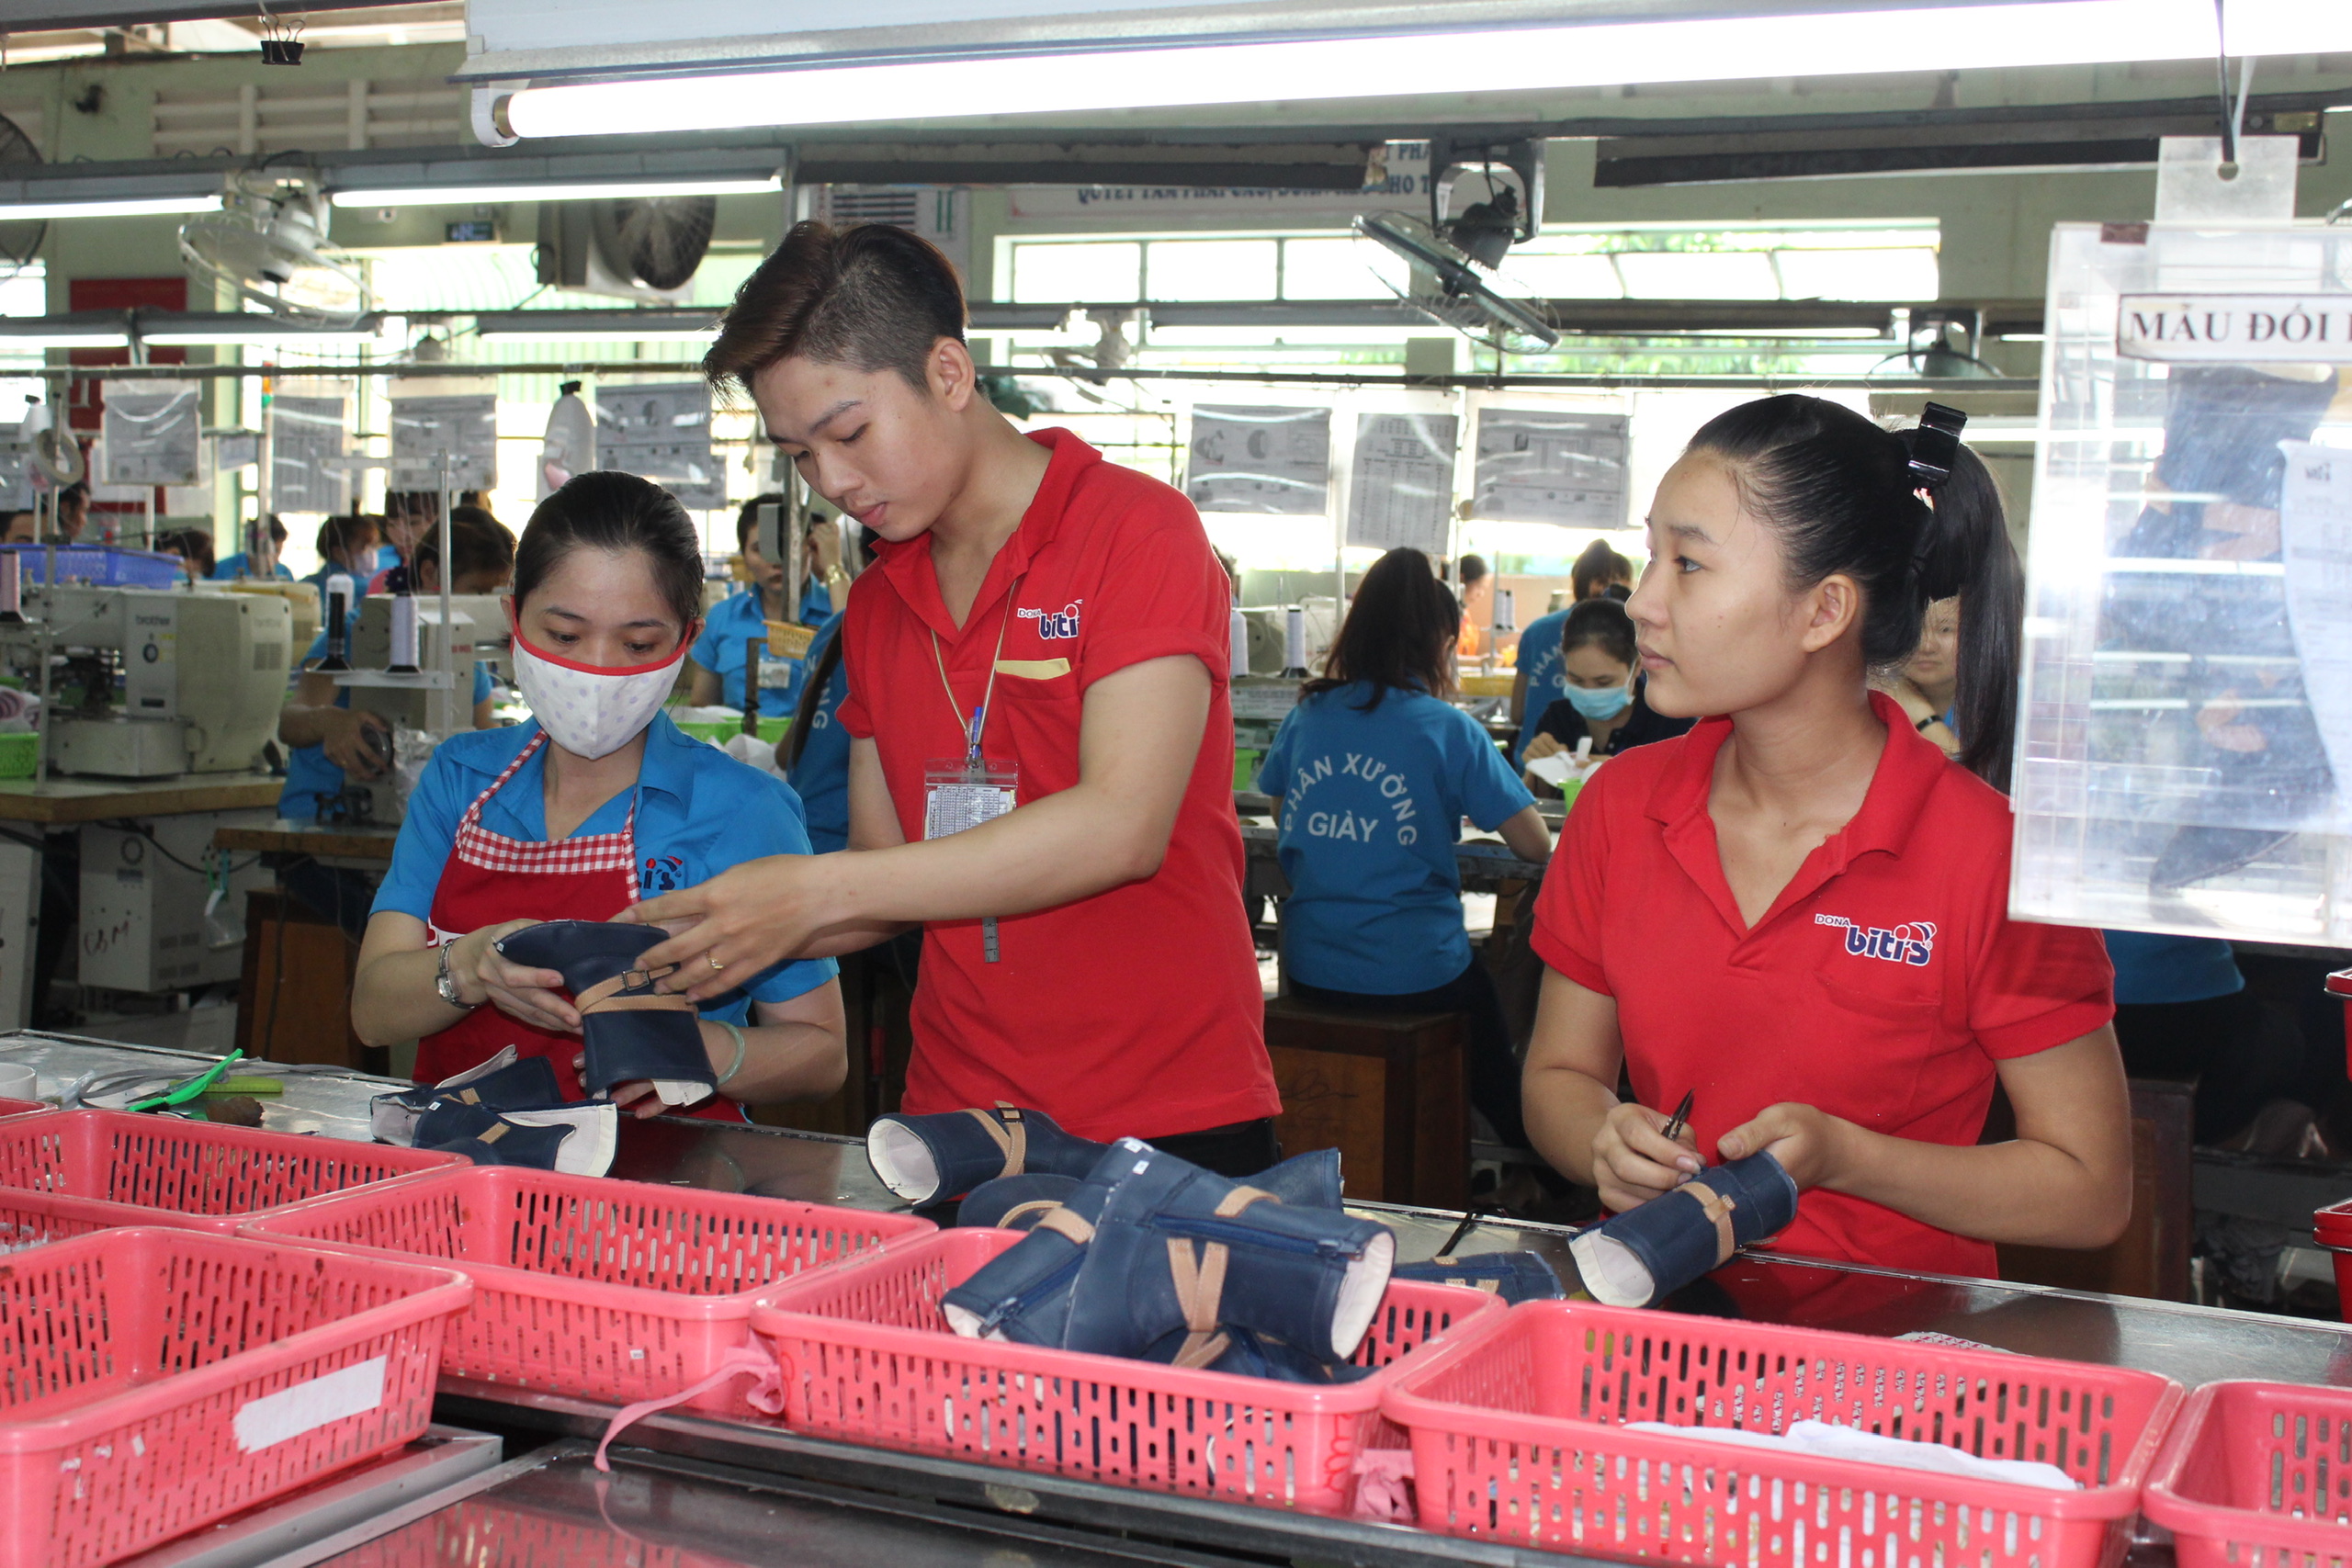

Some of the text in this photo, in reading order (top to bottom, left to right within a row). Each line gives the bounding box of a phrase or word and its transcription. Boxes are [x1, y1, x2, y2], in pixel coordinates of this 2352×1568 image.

[1284, 752, 1418, 846] PHÂN XƯỞNG
[1307, 809, 1379, 843] GIÀY
[1815, 913, 1850, 928] DONA
